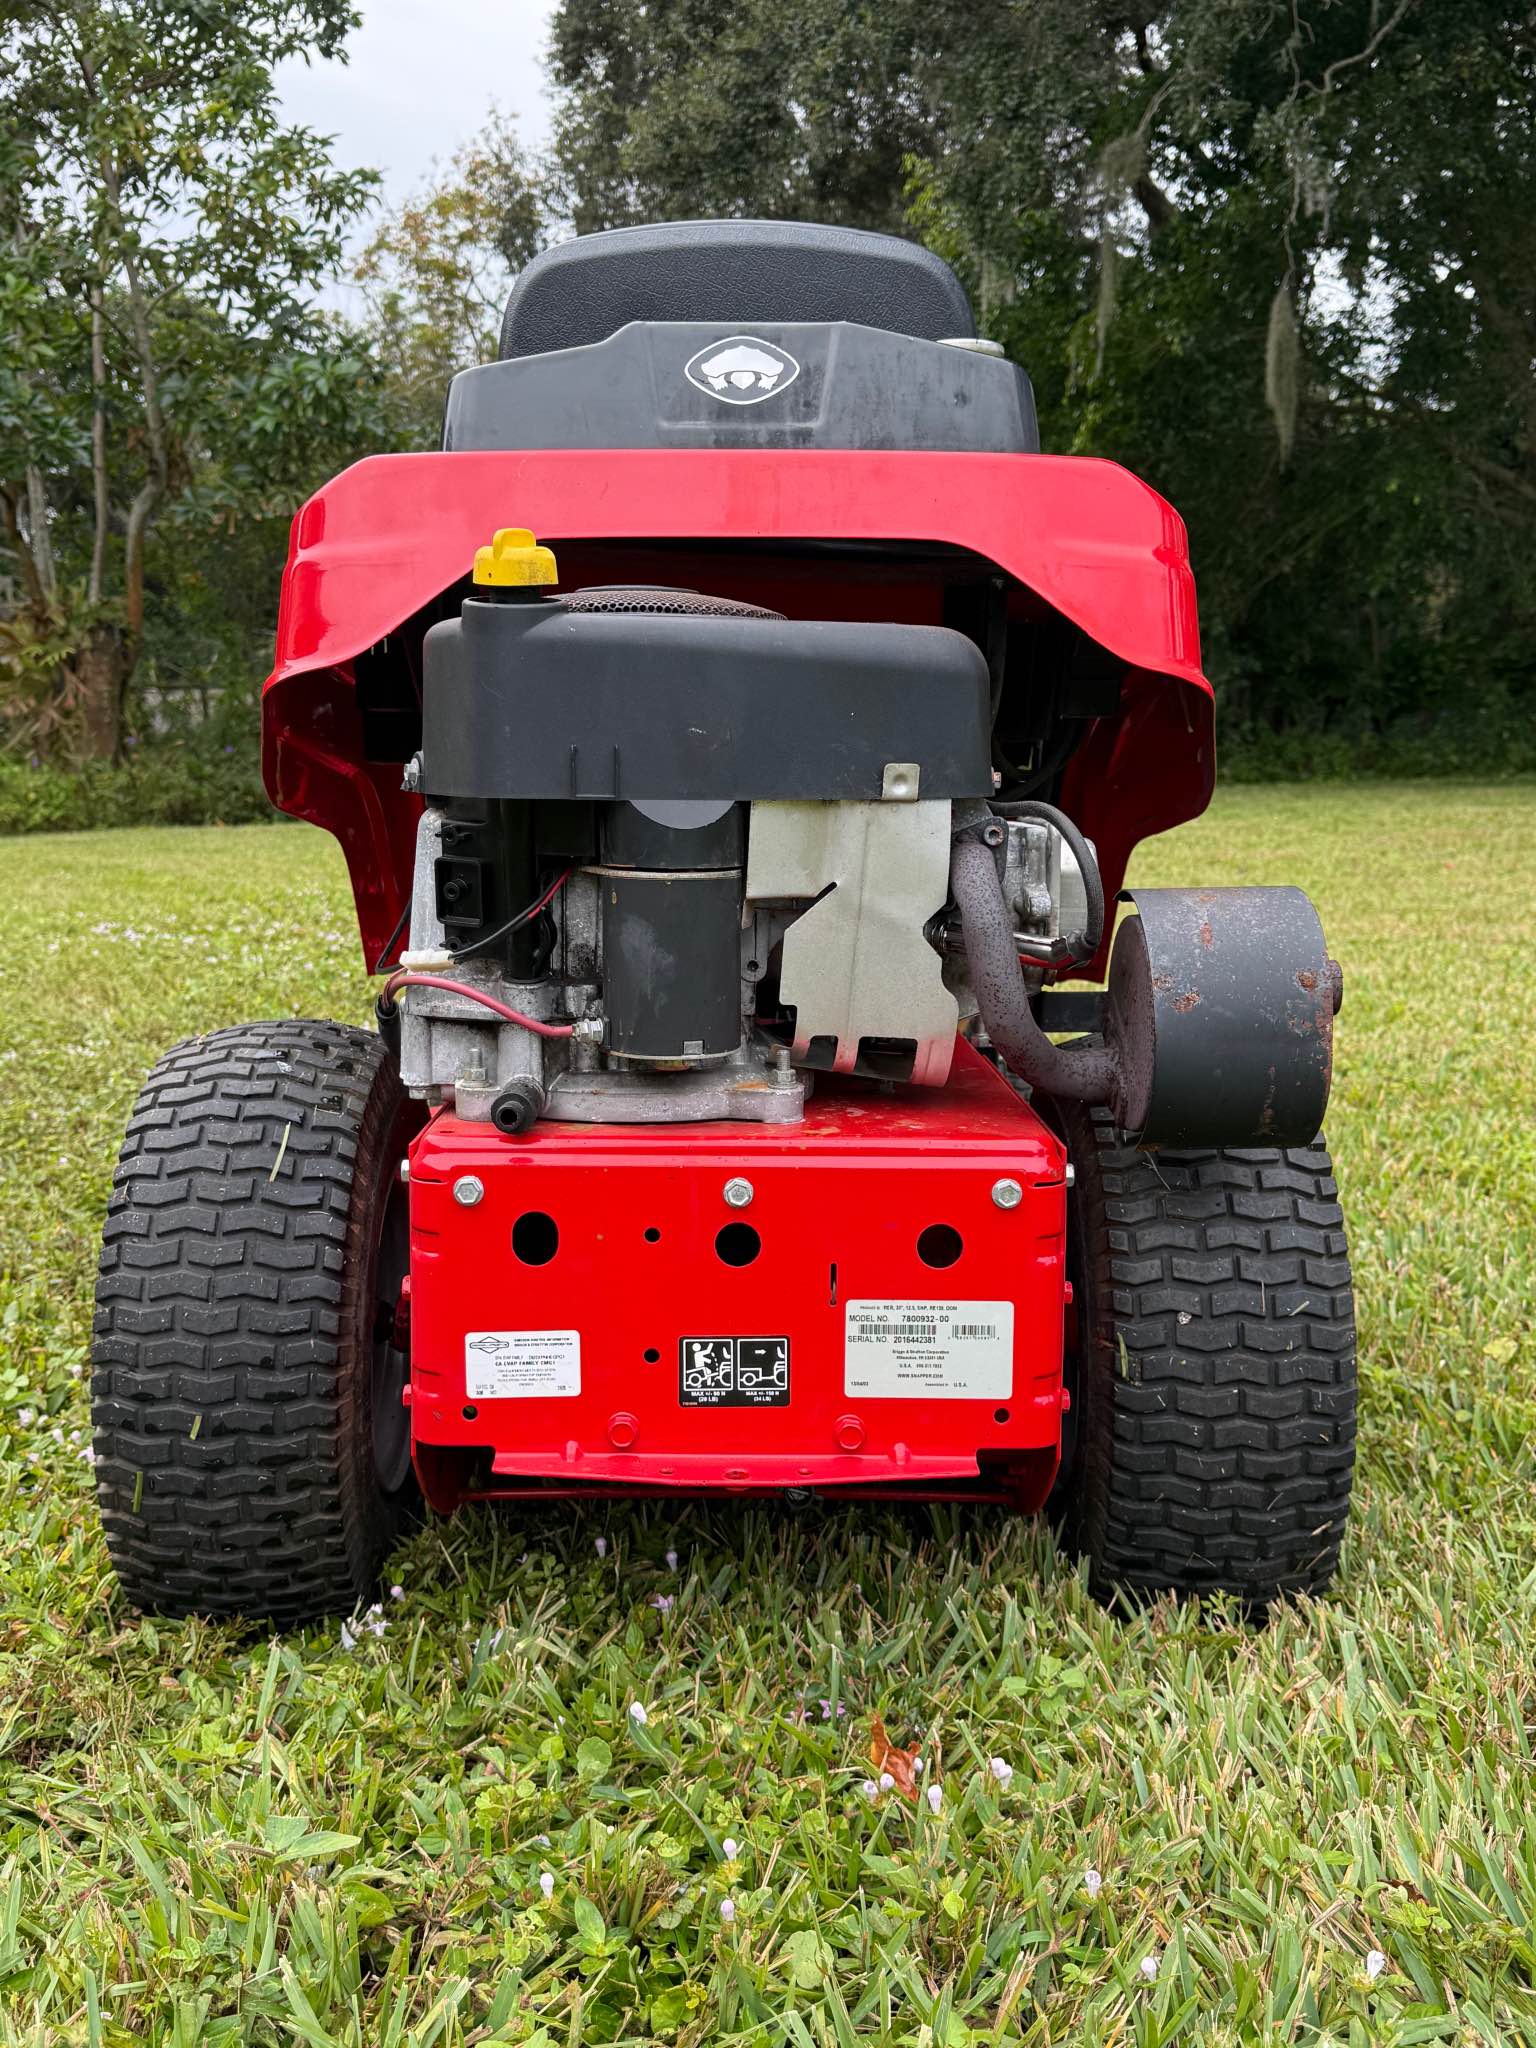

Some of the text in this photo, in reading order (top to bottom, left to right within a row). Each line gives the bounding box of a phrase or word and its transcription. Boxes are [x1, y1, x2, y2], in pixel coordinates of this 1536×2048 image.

[848, 1314, 950, 1324] MODEL NO. 7800932-00
[847, 1335, 936, 1344] SERIAL NO. 2016442381
